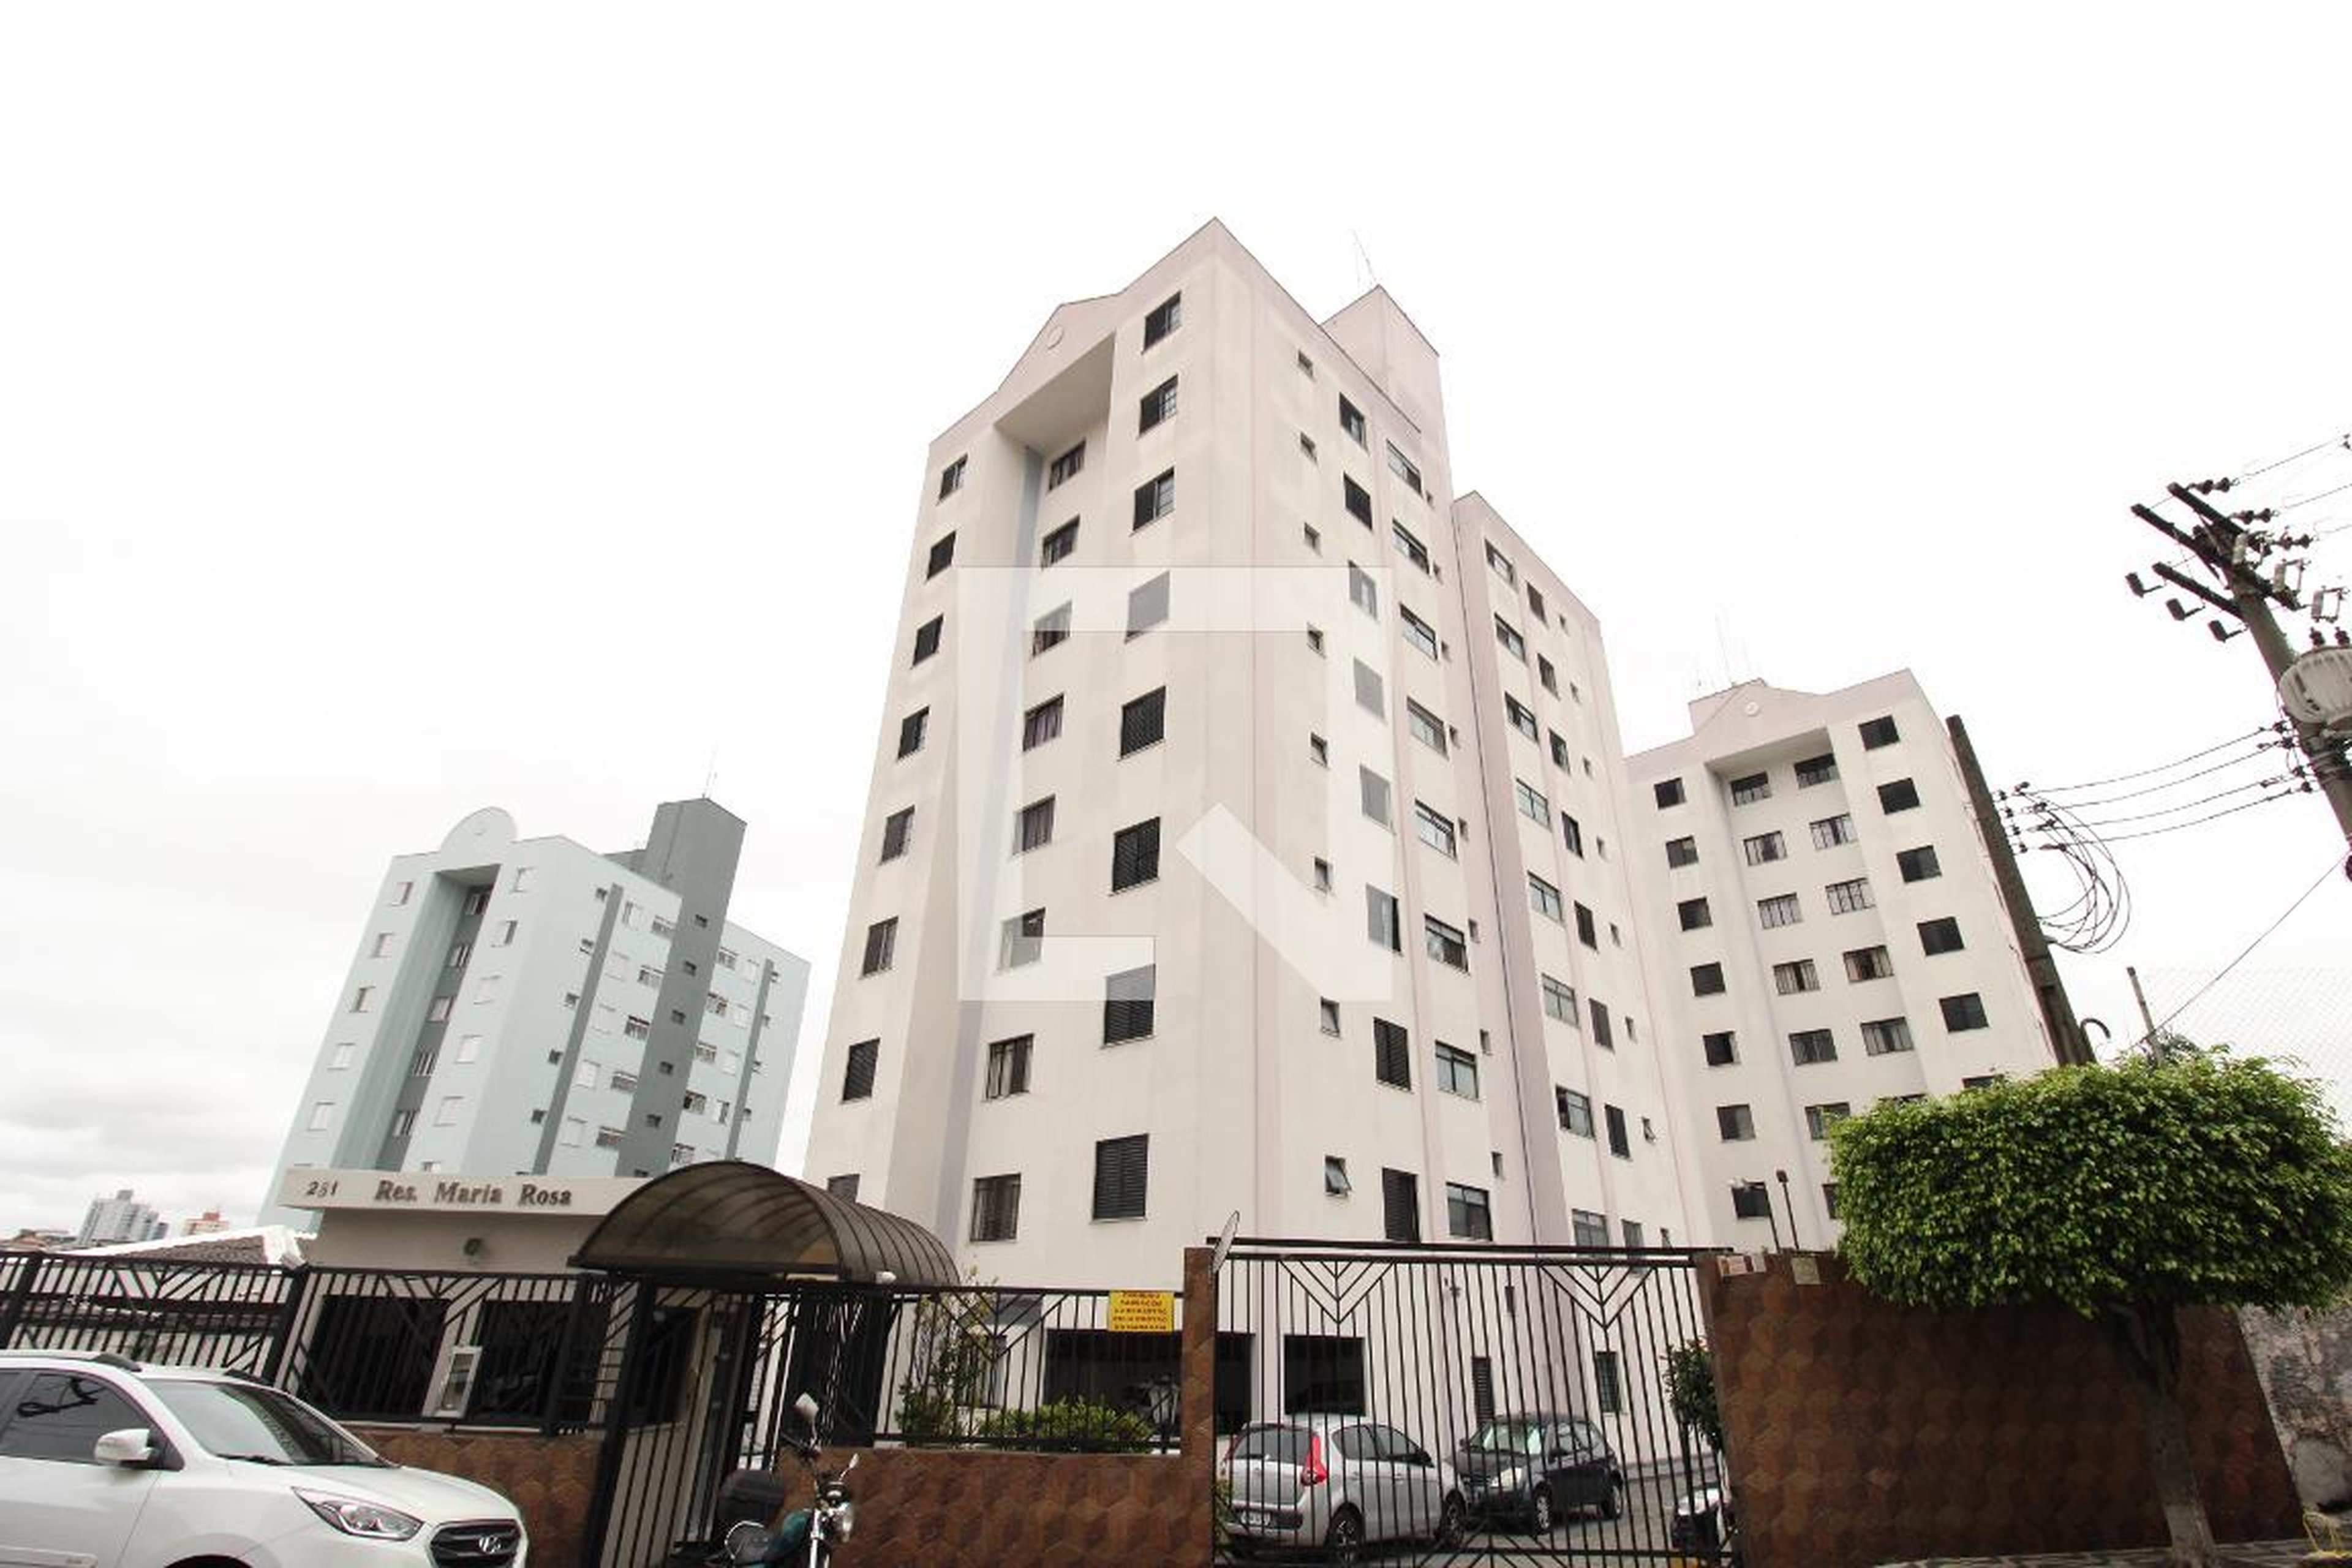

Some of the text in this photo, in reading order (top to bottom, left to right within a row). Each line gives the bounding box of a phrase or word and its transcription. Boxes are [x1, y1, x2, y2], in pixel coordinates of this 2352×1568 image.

[374, 1180, 571, 1205] Res. Maria Rosa
